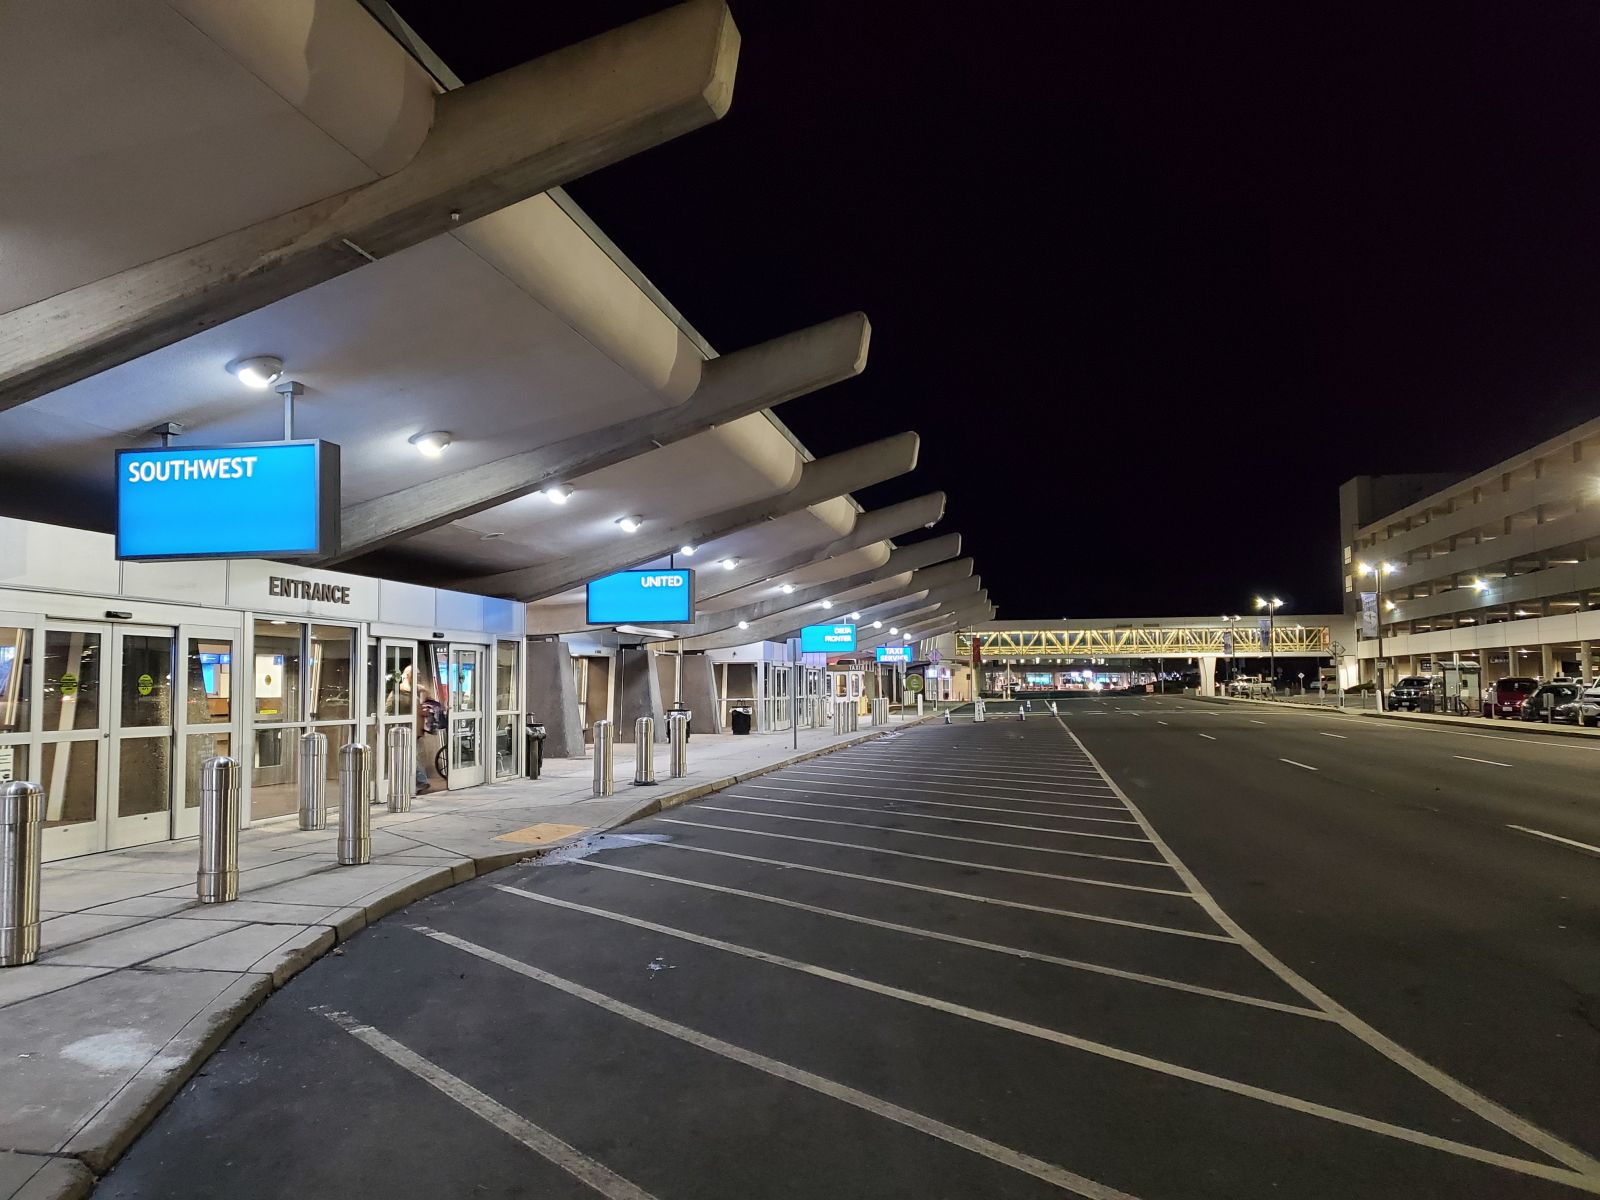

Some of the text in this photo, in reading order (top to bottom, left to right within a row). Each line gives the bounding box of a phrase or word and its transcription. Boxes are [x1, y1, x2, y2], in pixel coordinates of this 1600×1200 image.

[128, 456, 258, 483] SOUTHWEST
[268, 576, 351, 604] ENTRANCE
[640, 575, 684, 588] UNITED
